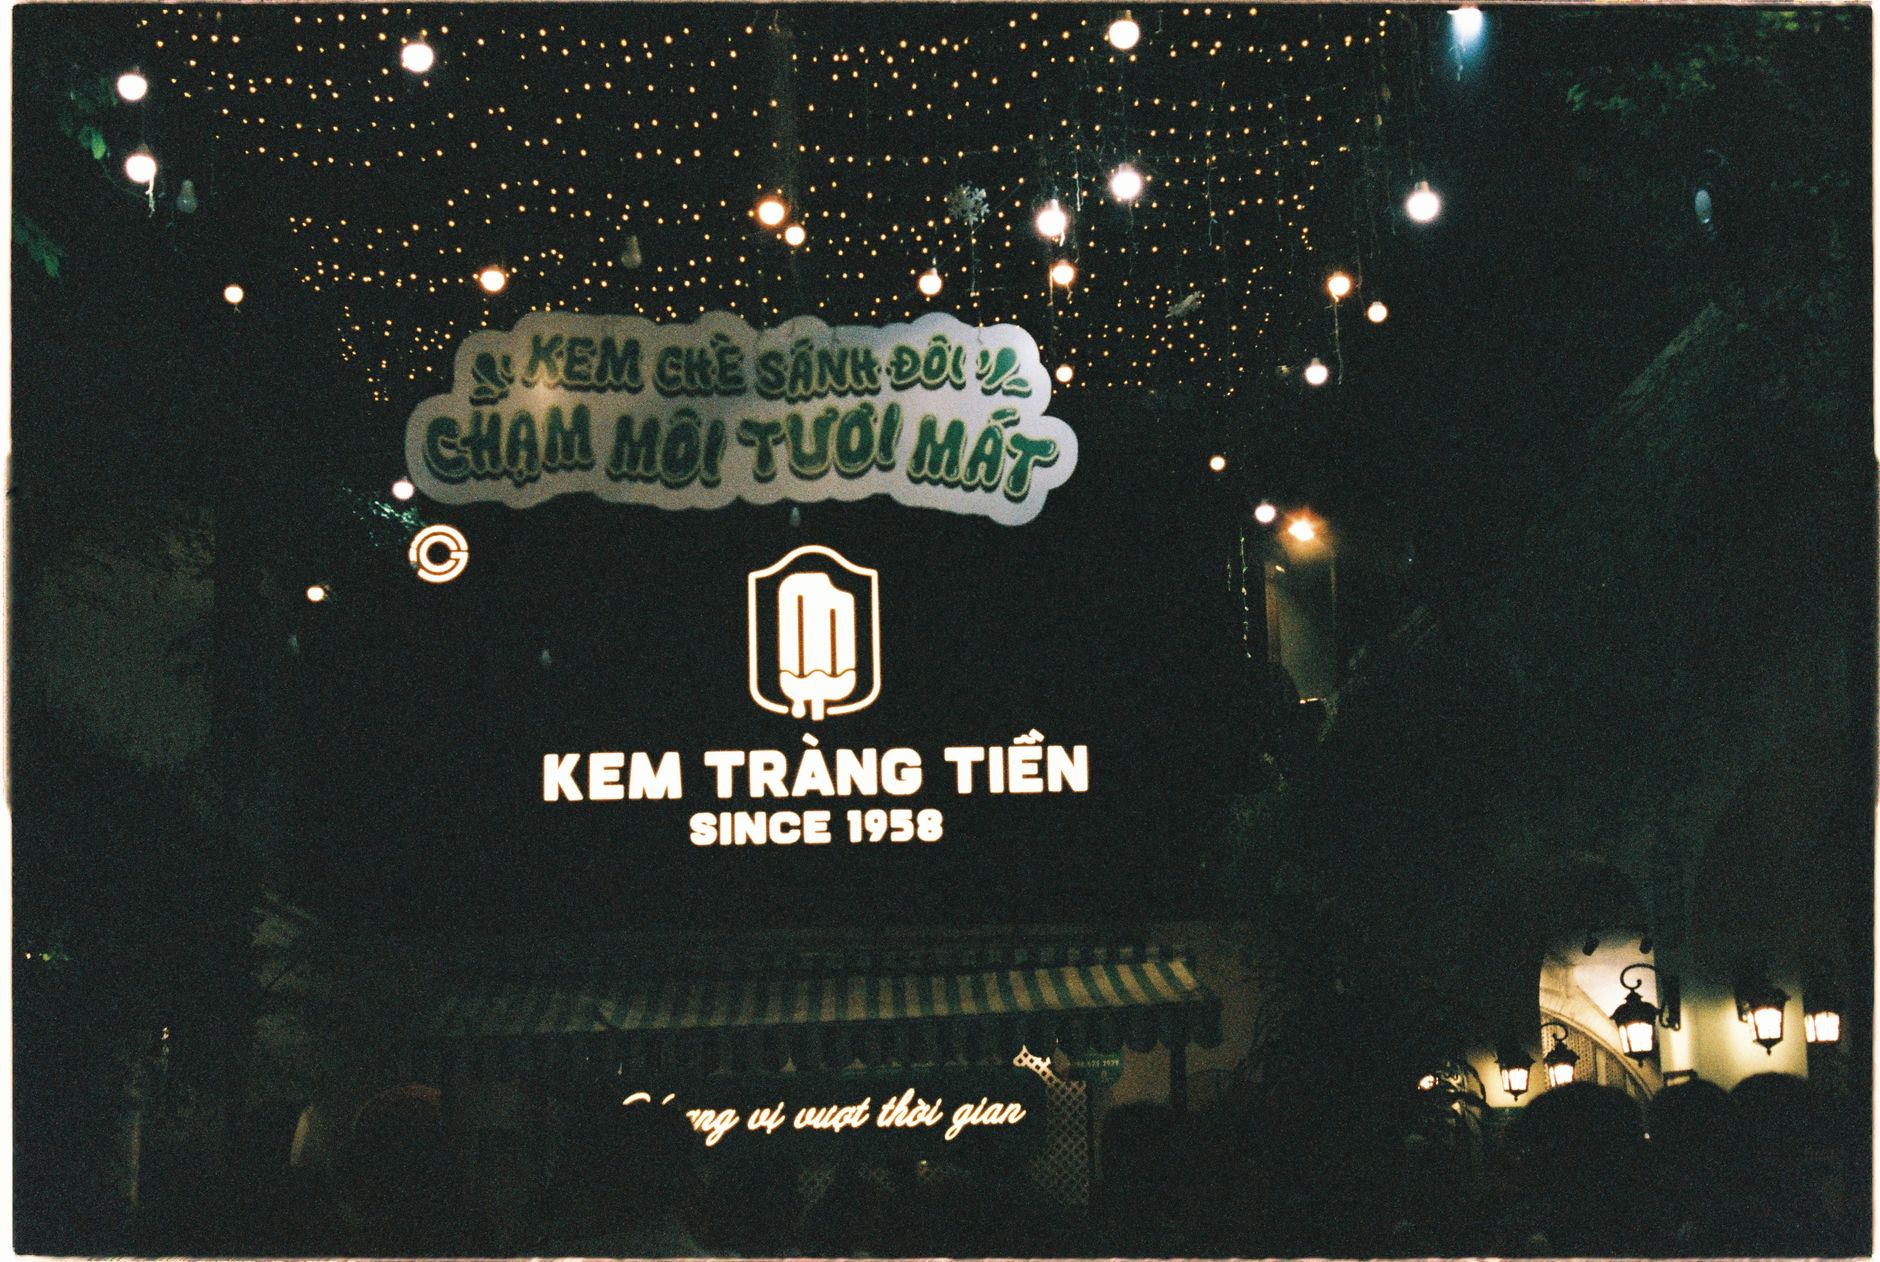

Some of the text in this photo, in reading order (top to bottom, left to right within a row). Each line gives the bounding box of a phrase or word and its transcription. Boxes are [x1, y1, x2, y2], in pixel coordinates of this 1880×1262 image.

[523, 331, 967, 404] KEM CHÈ SÁNH ĐÔI
[423, 401, 1059, 503] CHẠM MÔI TƯƠI MÁT
[543, 728, 1089, 802] KEM TRÀNG TIỀN
[689, 808, 944, 846] SINCE 1958
[746, 1101, 786, 1135] vị
[793, 1096, 871, 1133] vượt
[876, 1087, 943, 1128] thời
[944, 1096, 1027, 1141] gian
